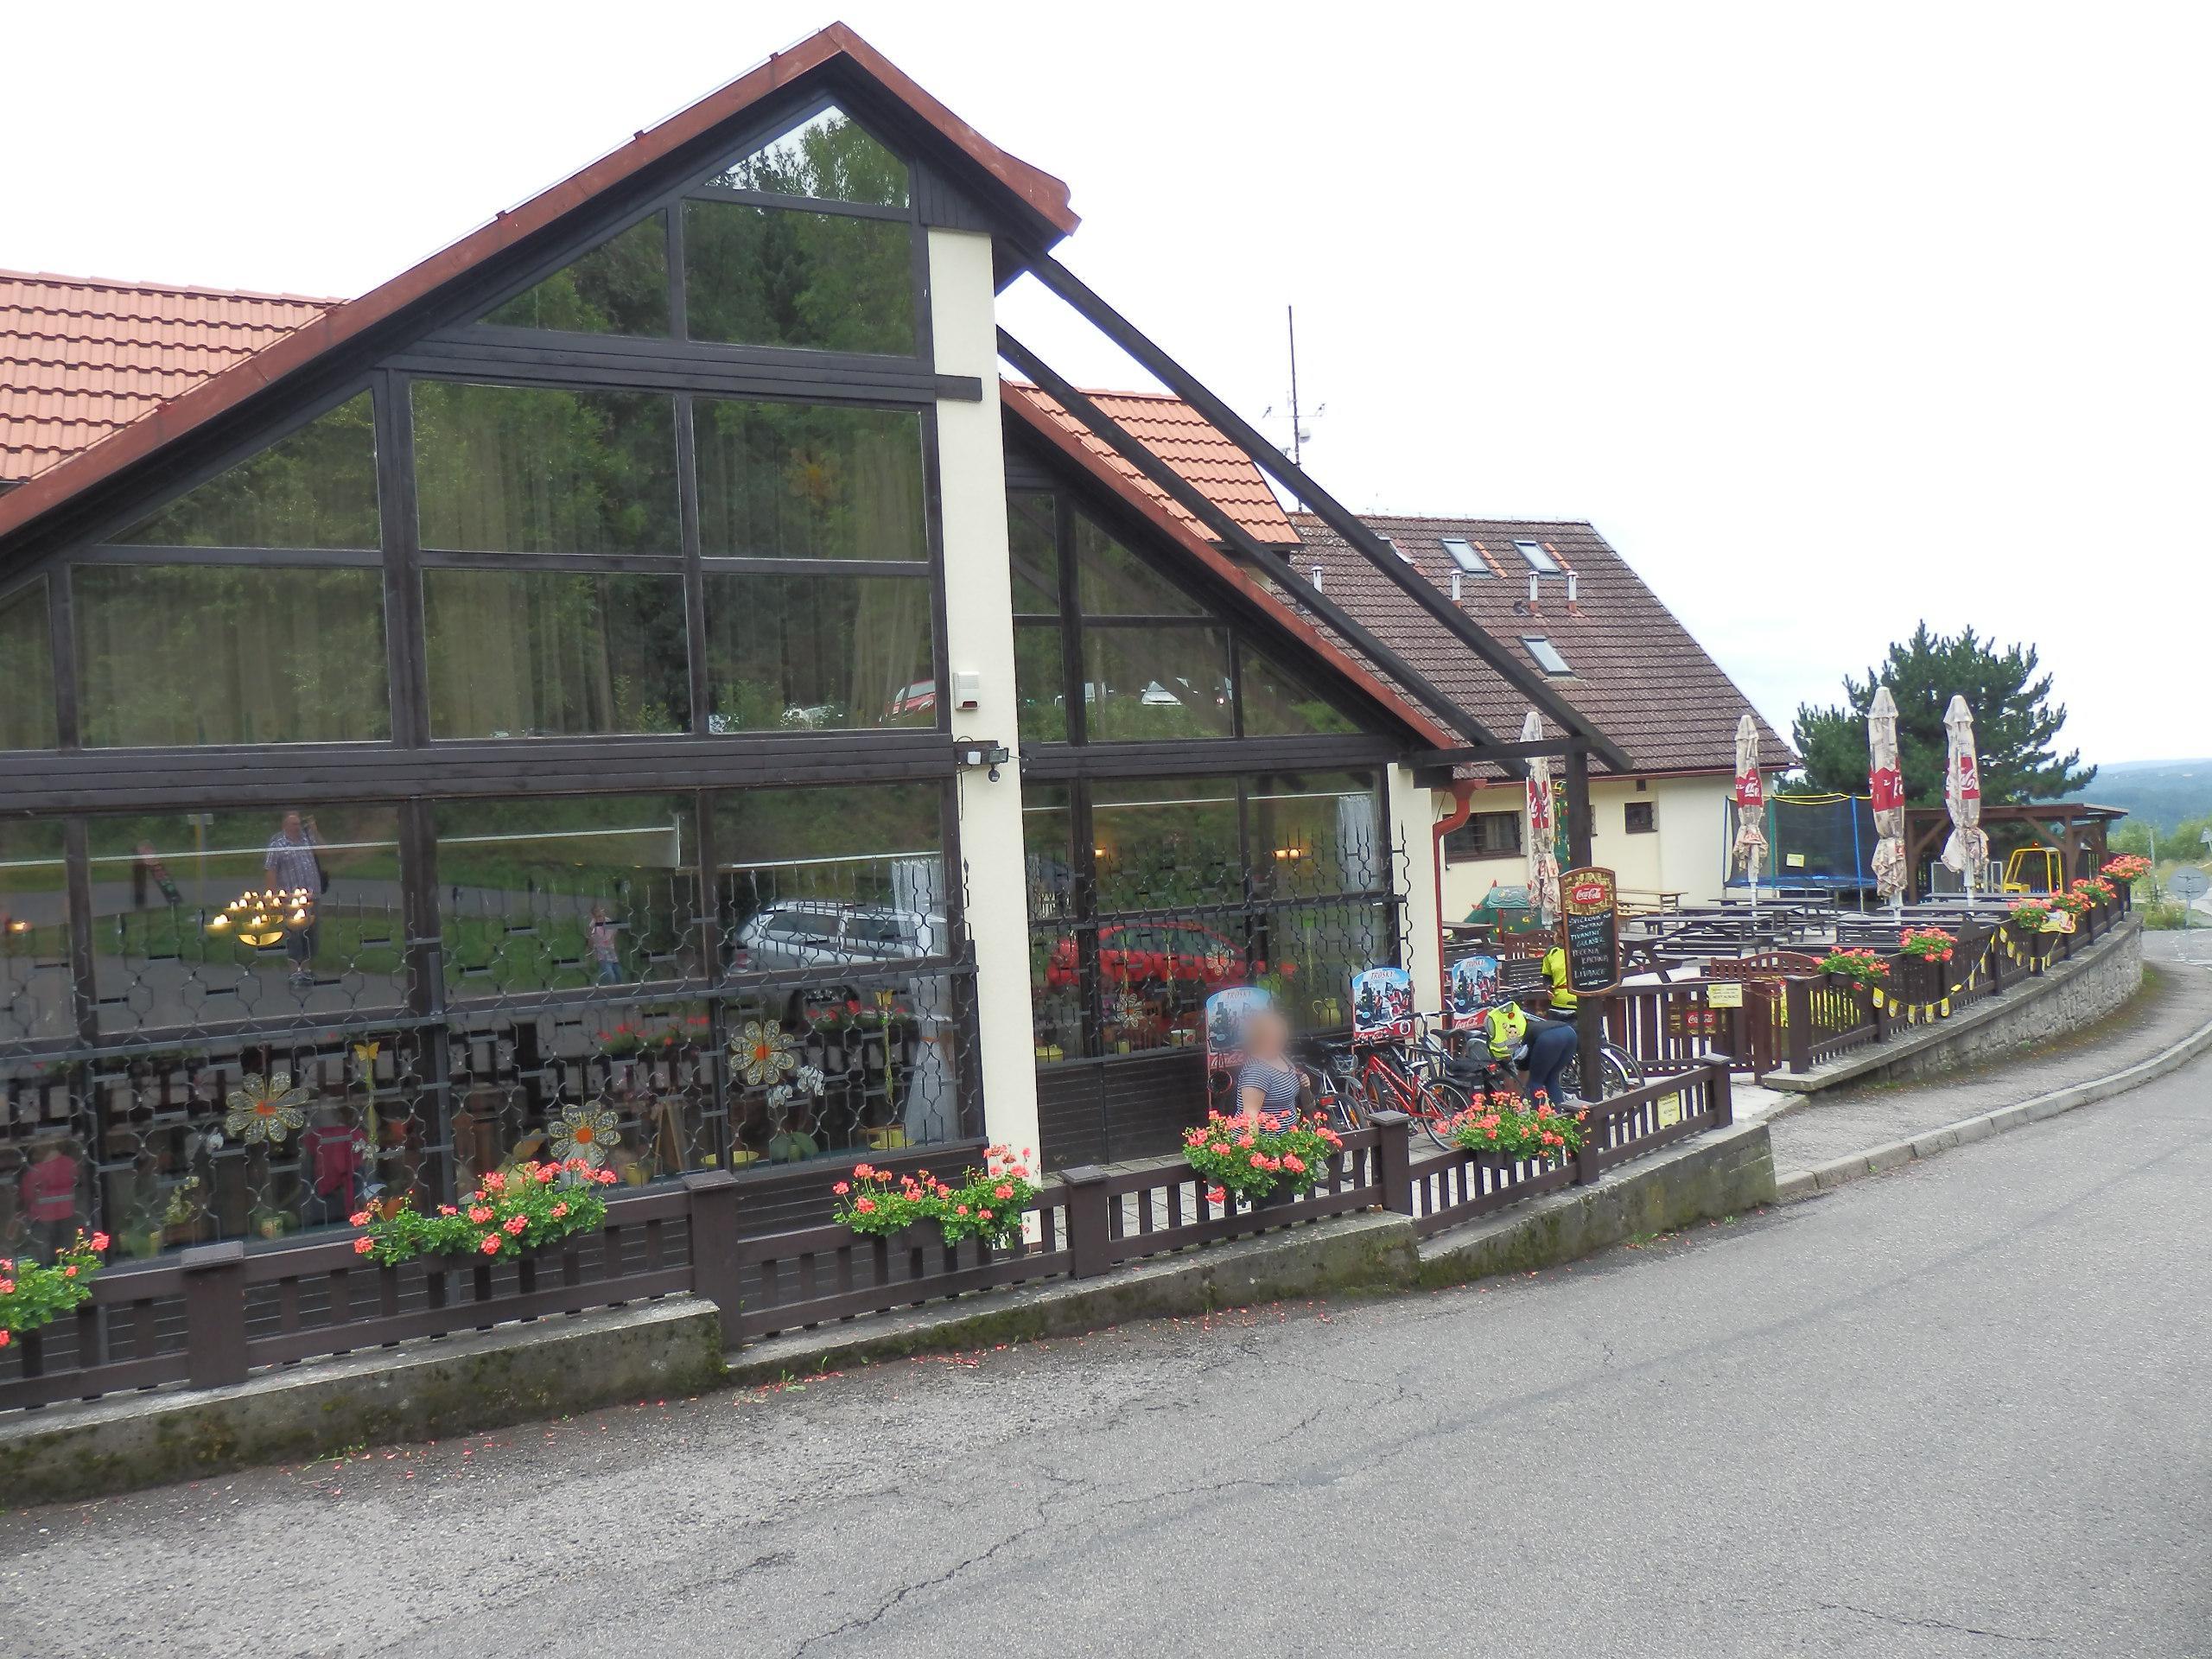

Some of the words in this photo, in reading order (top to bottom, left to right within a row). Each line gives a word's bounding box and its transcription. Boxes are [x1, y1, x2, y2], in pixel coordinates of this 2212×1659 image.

[1576, 887, 1601, 900] Coca-Cola
[1371, 971, 1393, 980] TROSKY
[1454, 1017, 1478, 1029] Coca-Cola
